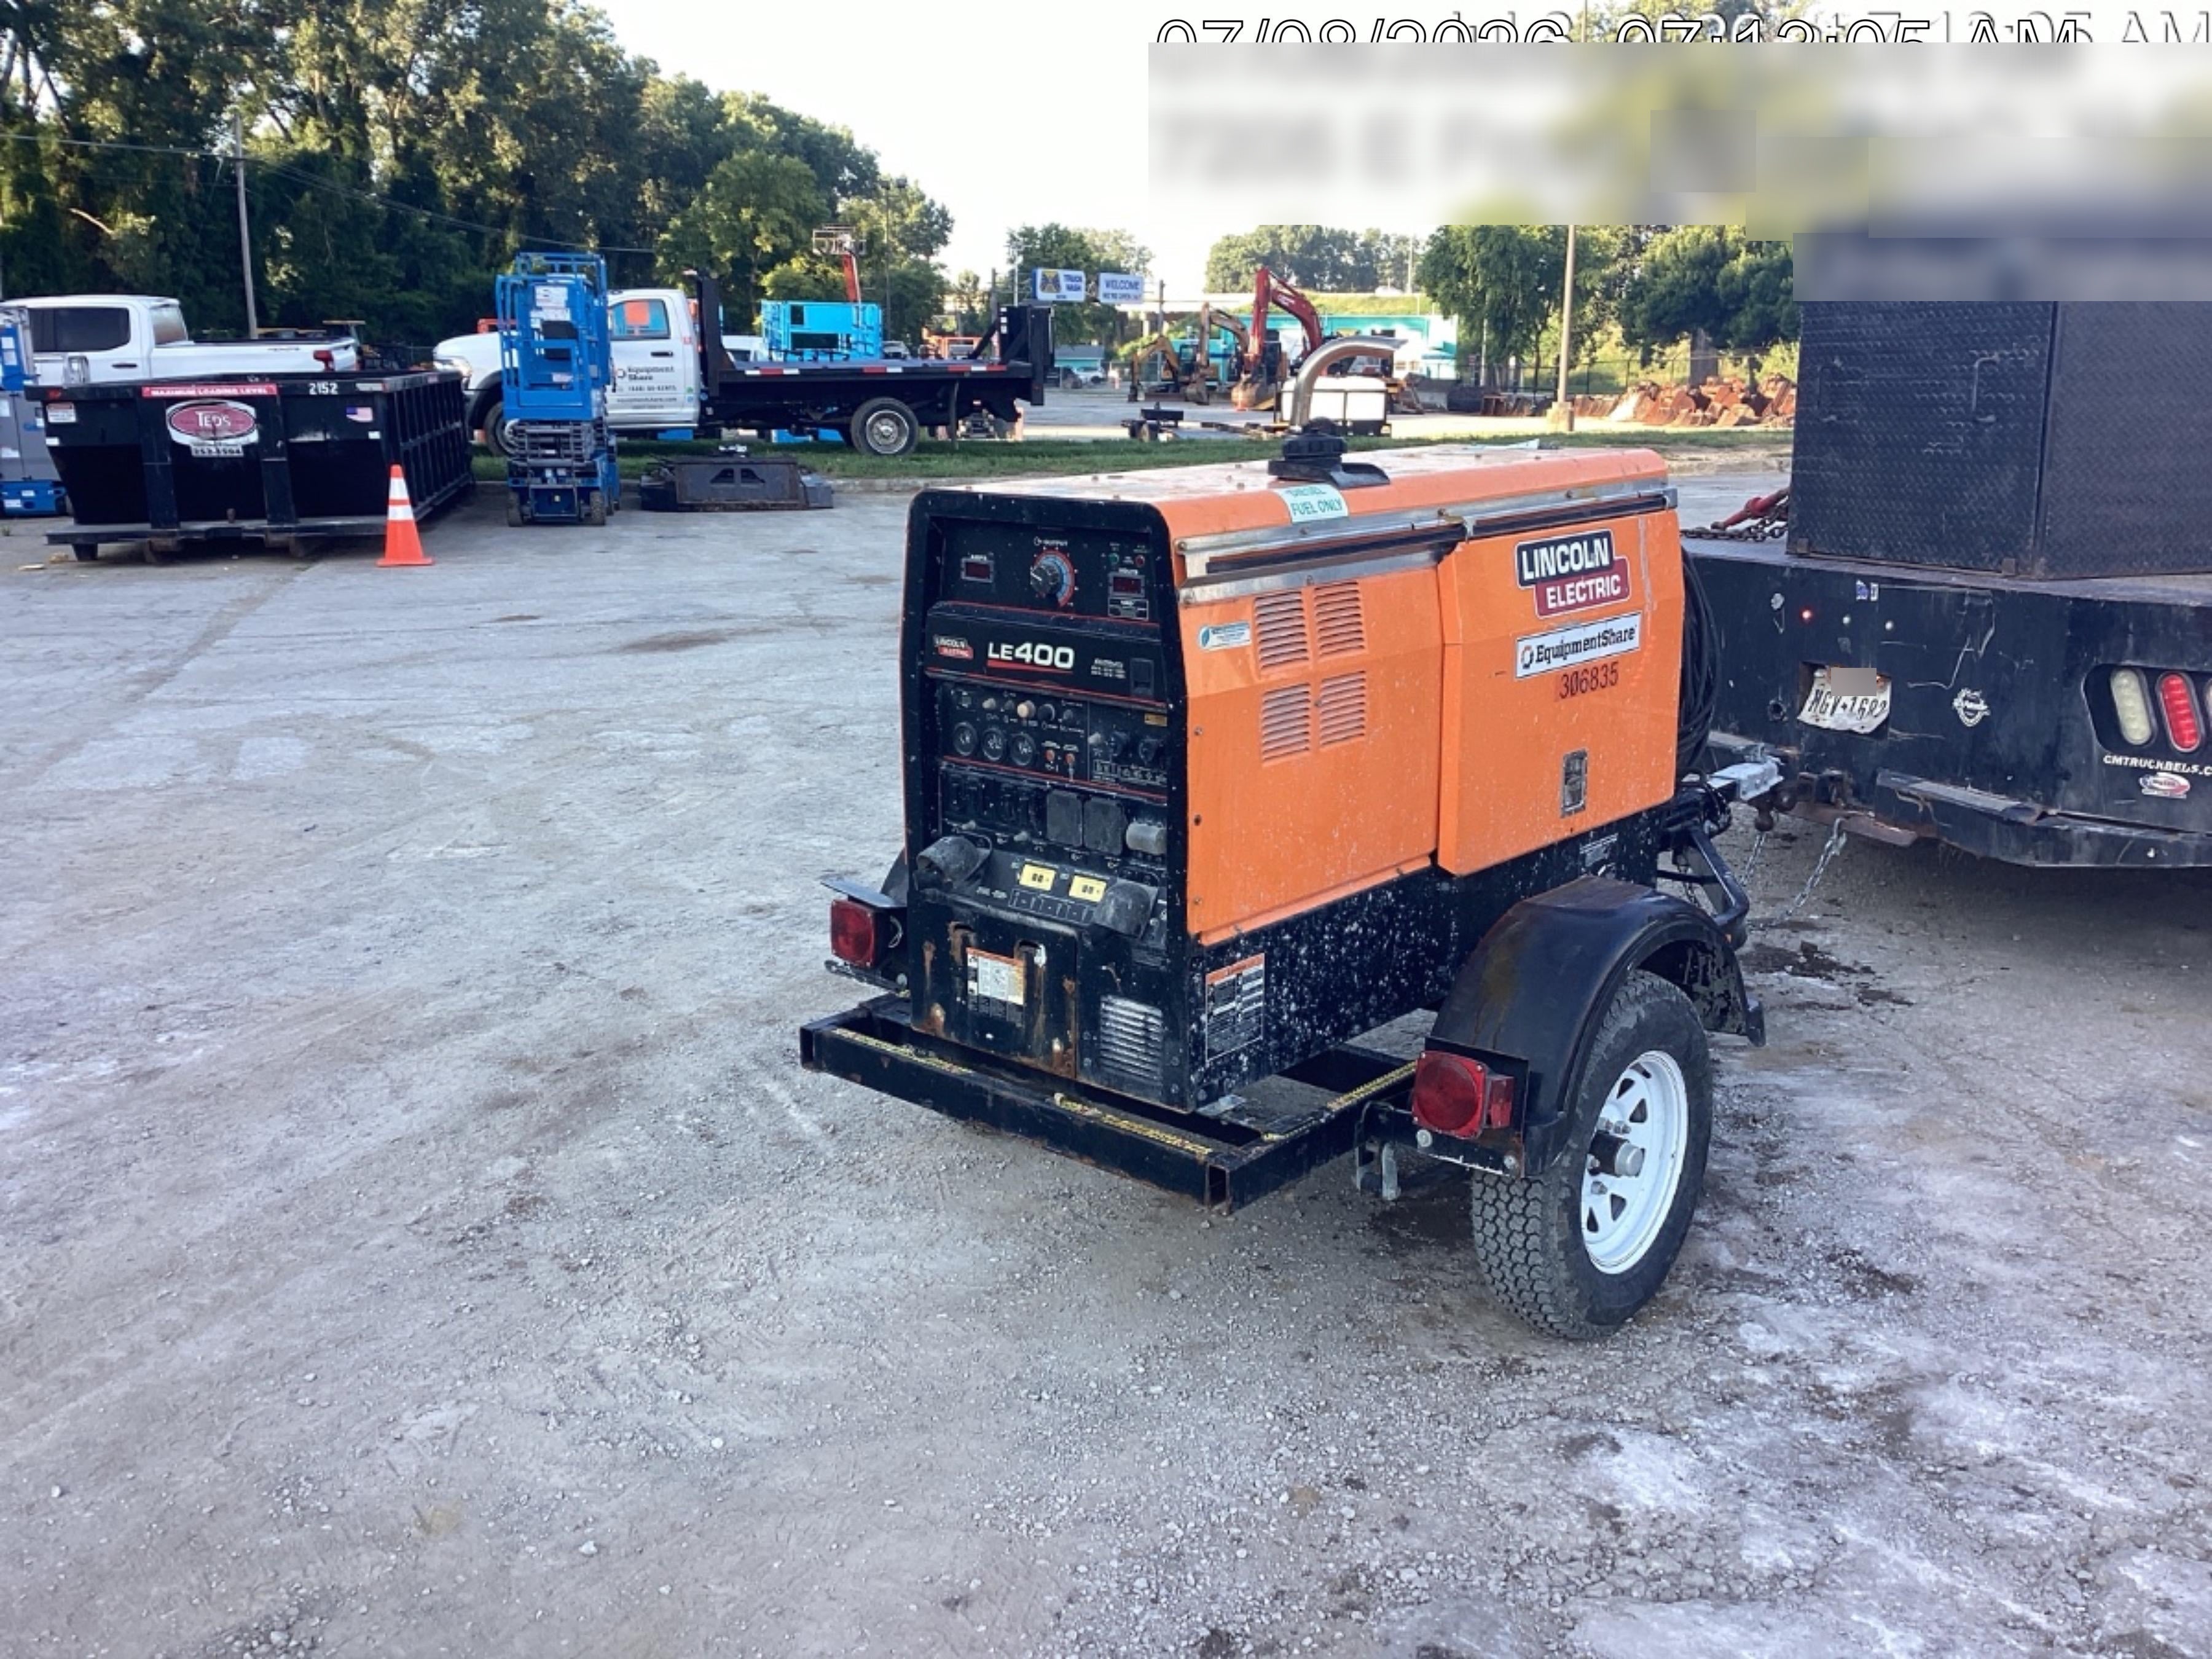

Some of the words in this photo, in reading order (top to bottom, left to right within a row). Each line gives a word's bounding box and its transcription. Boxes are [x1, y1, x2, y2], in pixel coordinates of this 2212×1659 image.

[1105, 280, 1140, 289] WELCOME
[309, 382, 339, 395] 2152
[1290, 501, 1317, 516] FUEL
[1318, 498, 1343, 513] ONLY
[1521, 537, 1610, 581] LINCOLN
[1546, 574, 1622, 609] ELECTRIC
[987, 641, 1075, 669] LE400
[1535, 626, 1636, 664] EquipmentShare
[1559, 661, 1620, 699] 306835
